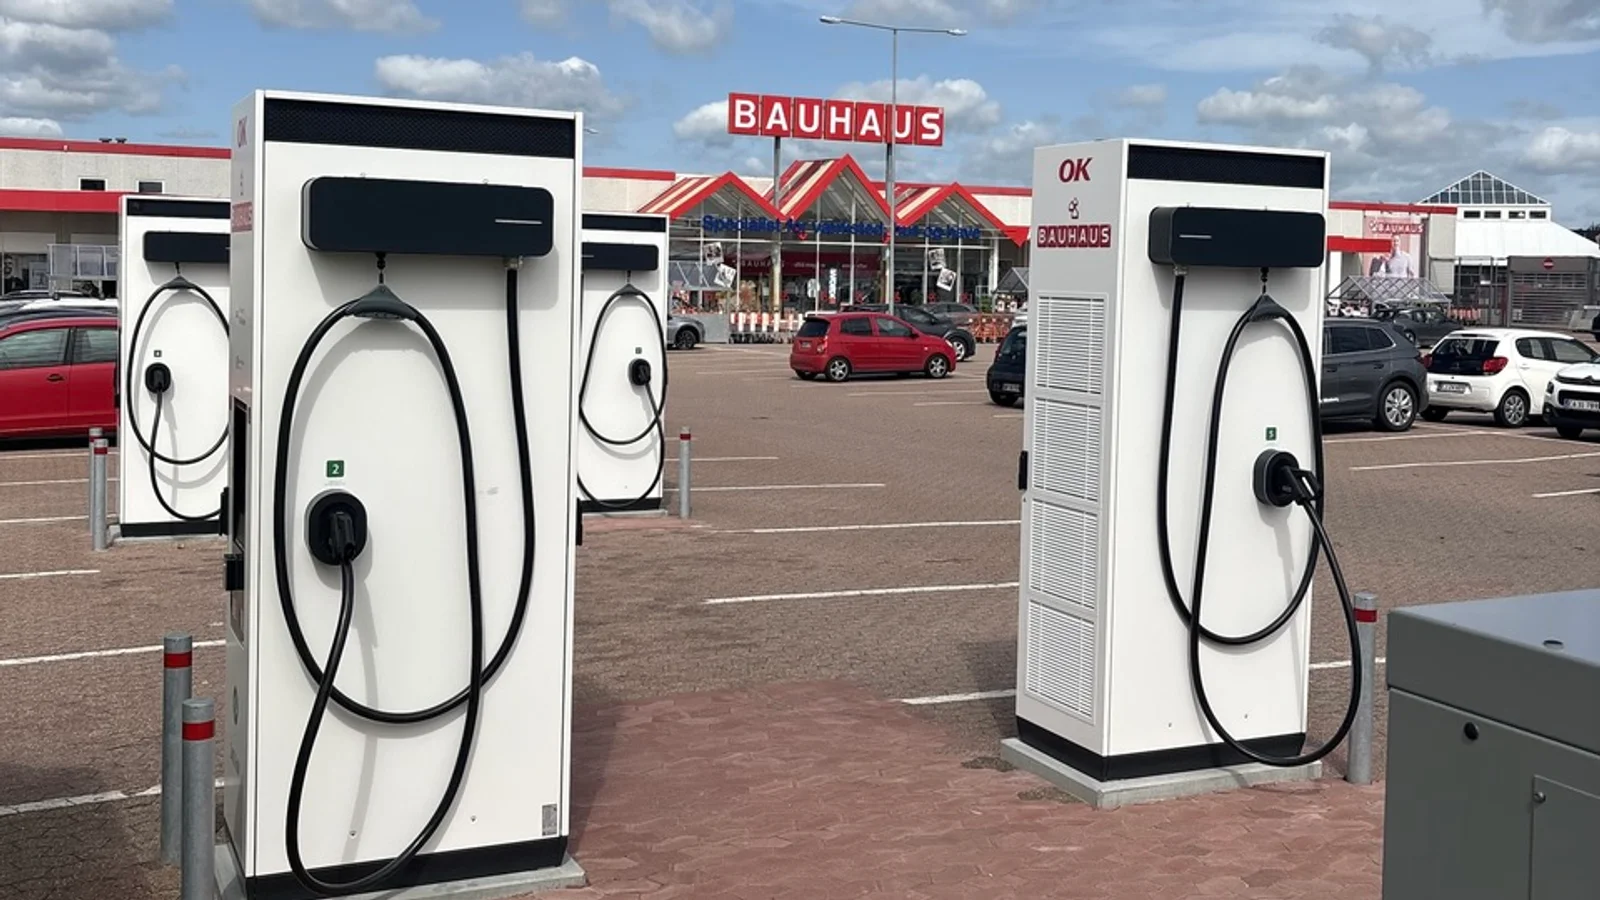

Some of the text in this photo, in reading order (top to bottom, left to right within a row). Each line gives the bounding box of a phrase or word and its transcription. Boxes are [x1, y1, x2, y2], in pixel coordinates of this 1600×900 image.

[734, 99, 941, 140] BAUHAUS
[1058, 157, 1093, 183] OK
[1038, 227, 1110, 244] BAUHAUS
[331, 463, 340, 475] 2
